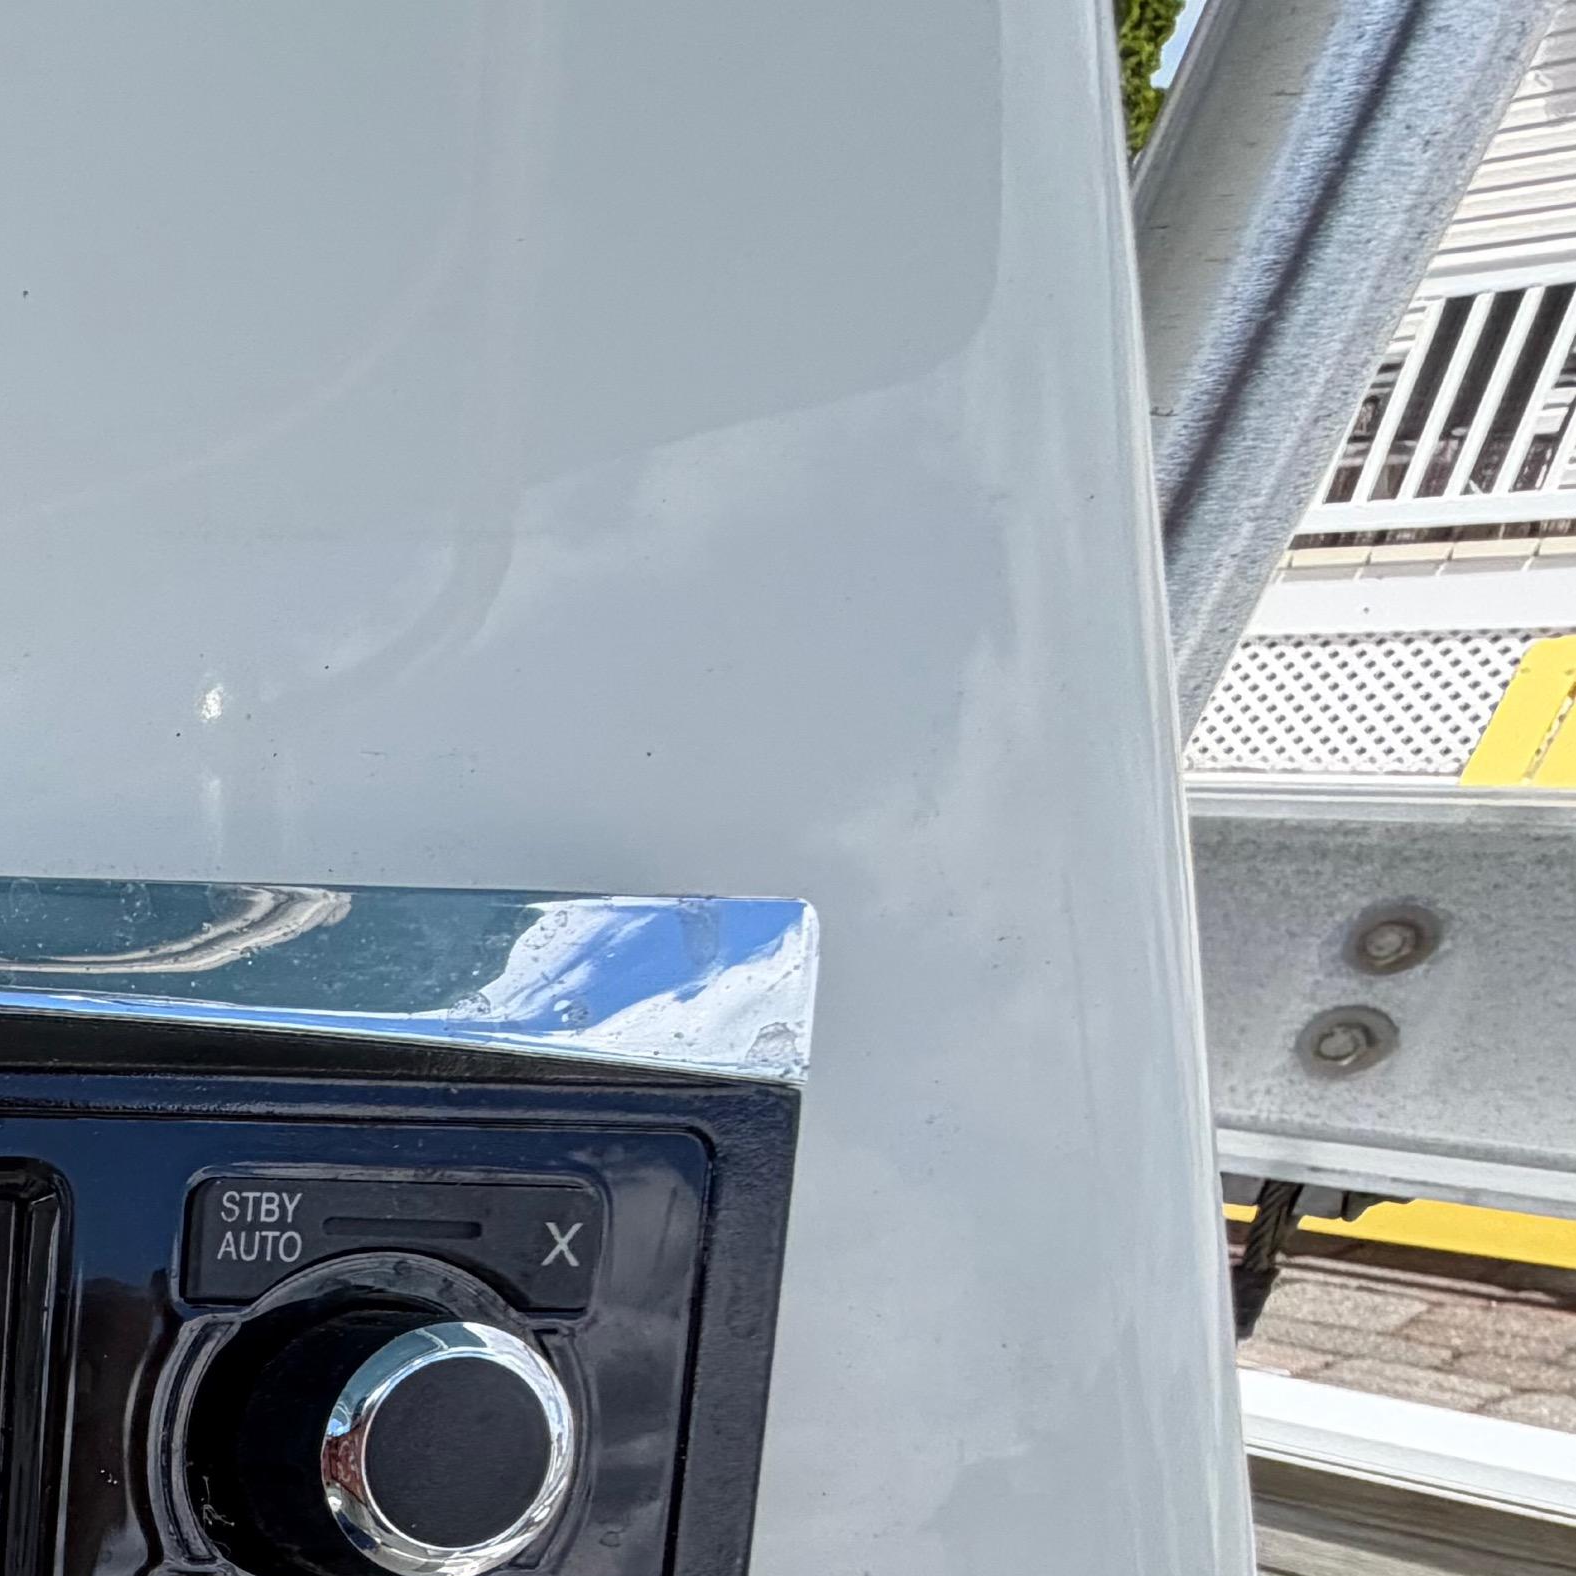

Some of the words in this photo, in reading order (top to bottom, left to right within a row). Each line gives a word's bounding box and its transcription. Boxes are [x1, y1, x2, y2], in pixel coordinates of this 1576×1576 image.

[220, 1191, 303, 1224] STBY
[217, 1230, 303, 1263] AUTO
[541, 1222, 584, 1267] X
